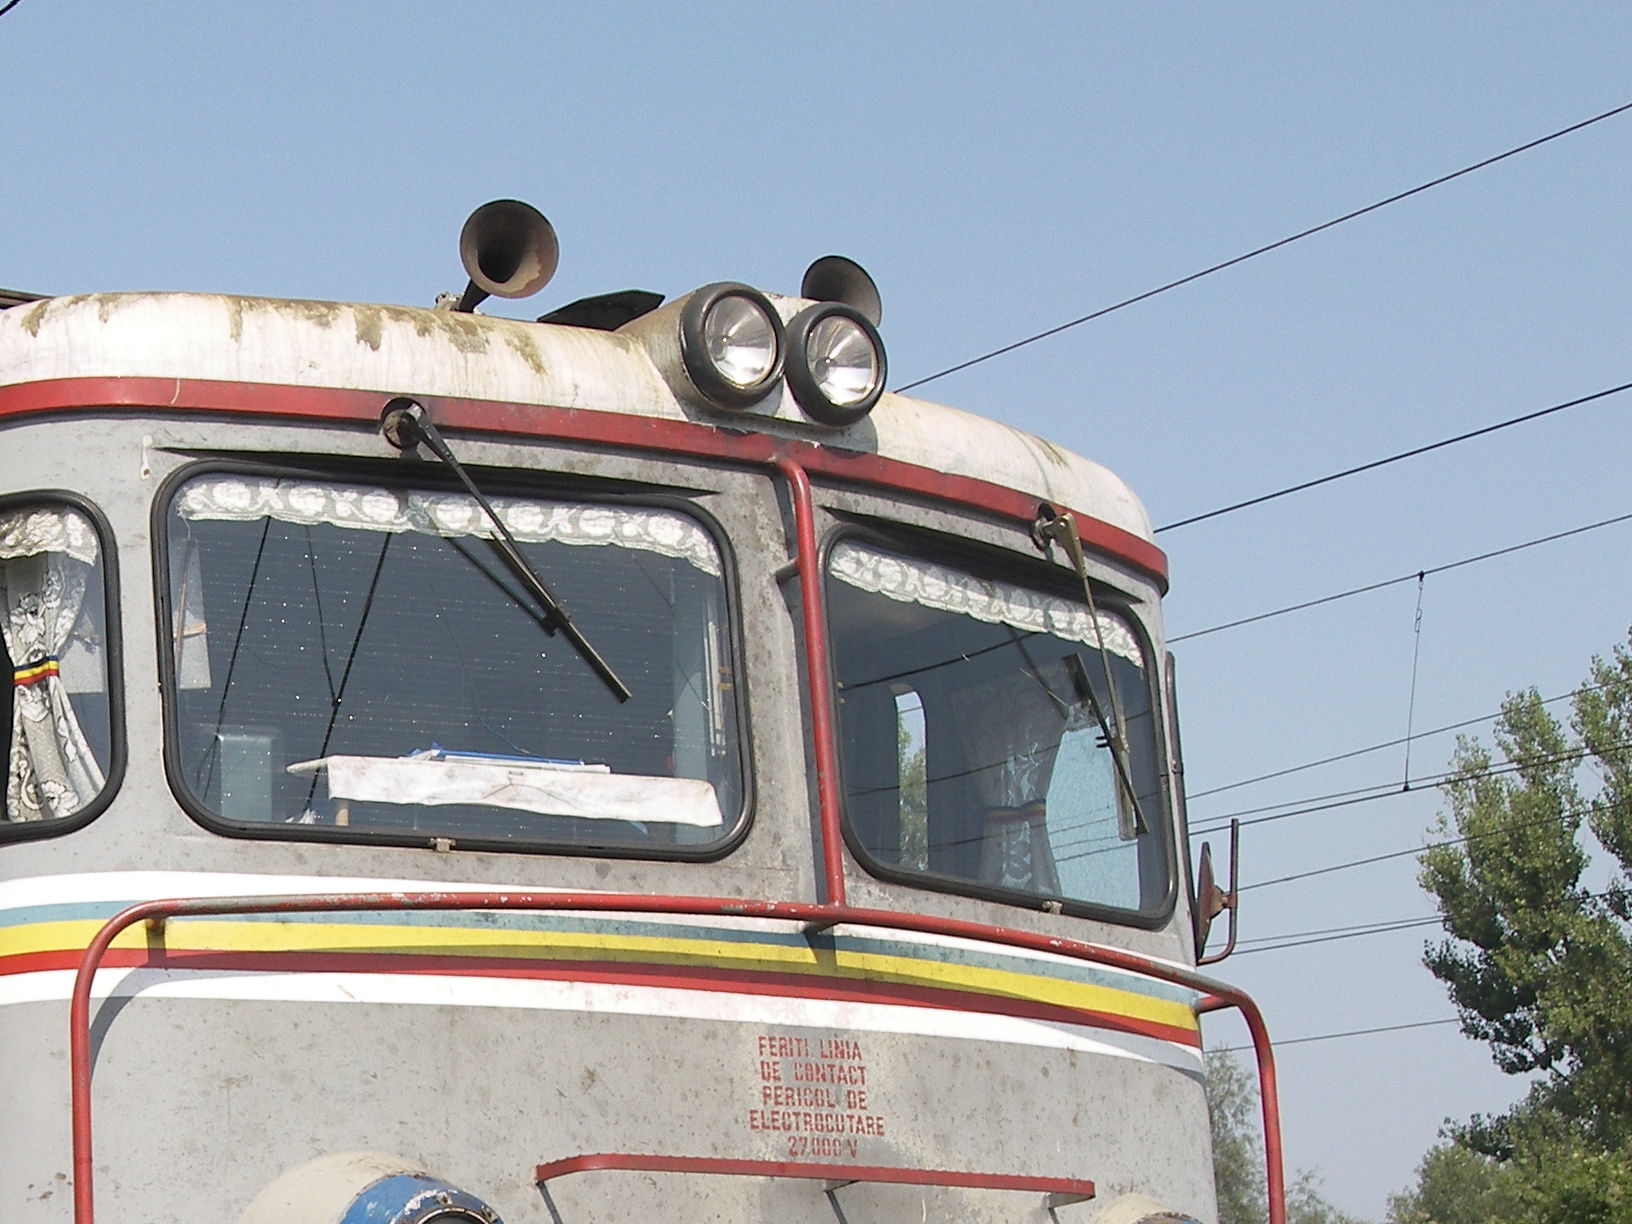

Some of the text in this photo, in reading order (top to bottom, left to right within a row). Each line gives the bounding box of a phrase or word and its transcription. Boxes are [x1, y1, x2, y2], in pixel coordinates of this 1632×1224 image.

[757, 1036, 862, 1061] FERITI LINIA
[759, 1060, 867, 1086] DE CONTACT
[762, 1085, 868, 1111] PERICOL DE
[749, 1109, 885, 1137] ELECTROCUTARE
